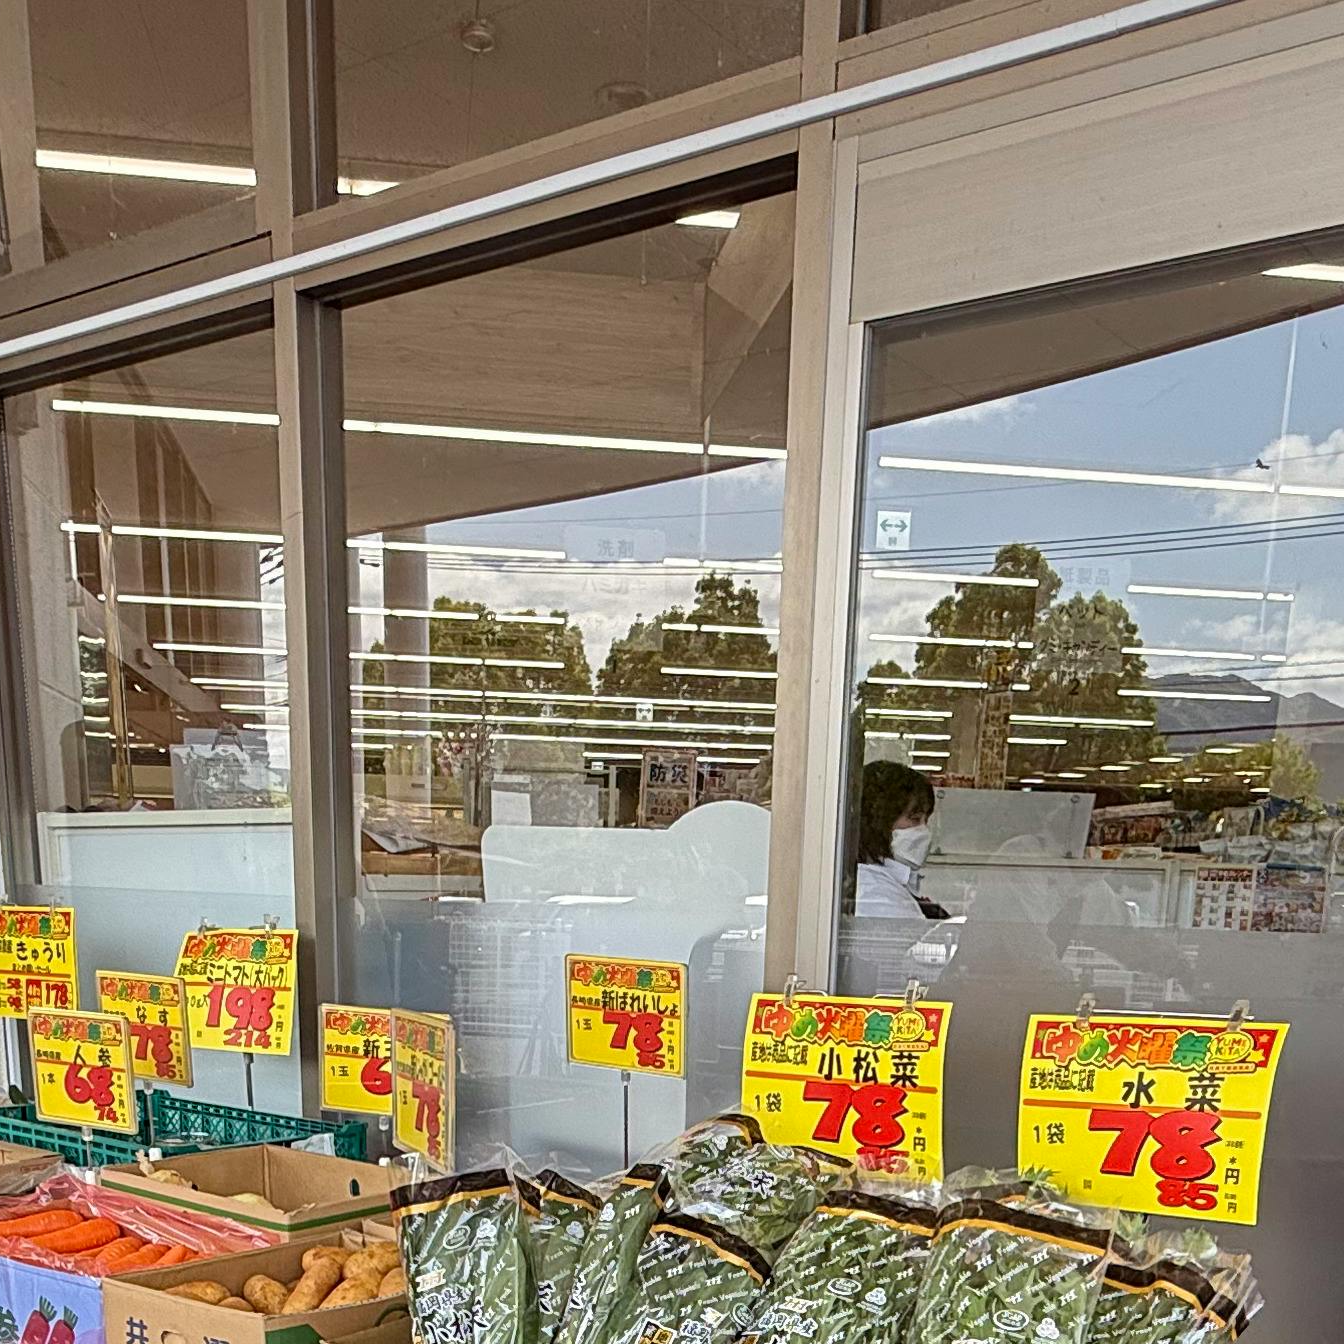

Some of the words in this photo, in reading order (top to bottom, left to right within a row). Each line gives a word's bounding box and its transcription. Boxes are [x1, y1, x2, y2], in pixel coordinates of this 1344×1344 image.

[649, 763, 689, 784] 防災
[16, 941, 66, 963] きゅうり
[136, 1006, 169, 1026] なす
[206, 982, 275, 1031] 198
[601, 989, 678, 1016] 新ばれいしょ
[130, 1024, 174, 1063] 78
[223, 1029, 272, 1049] 214
[603, 1011, 664, 1052] 78
[73, 1045, 111, 1067] 人参
[818, 1047, 920, 1089] 小松菜
[330, 1065, 349, 1077] 1玉
[65, 1063, 115, 1107] 68
[1121, 1072, 1225, 1112] 水菜
[412, 1081, 441, 1138] 78
[754, 1093, 782, 1113] 1袋
[803, 1080, 908, 1148] 78
[913, 1137, 926, 1152] 円
[1033, 1122, 1065, 1144] 1袋
[1088, 1108, 1223, 1182] 78
[1224, 1167, 1240, 1185] 円
[1156, 1179, 1218, 1211] 85
